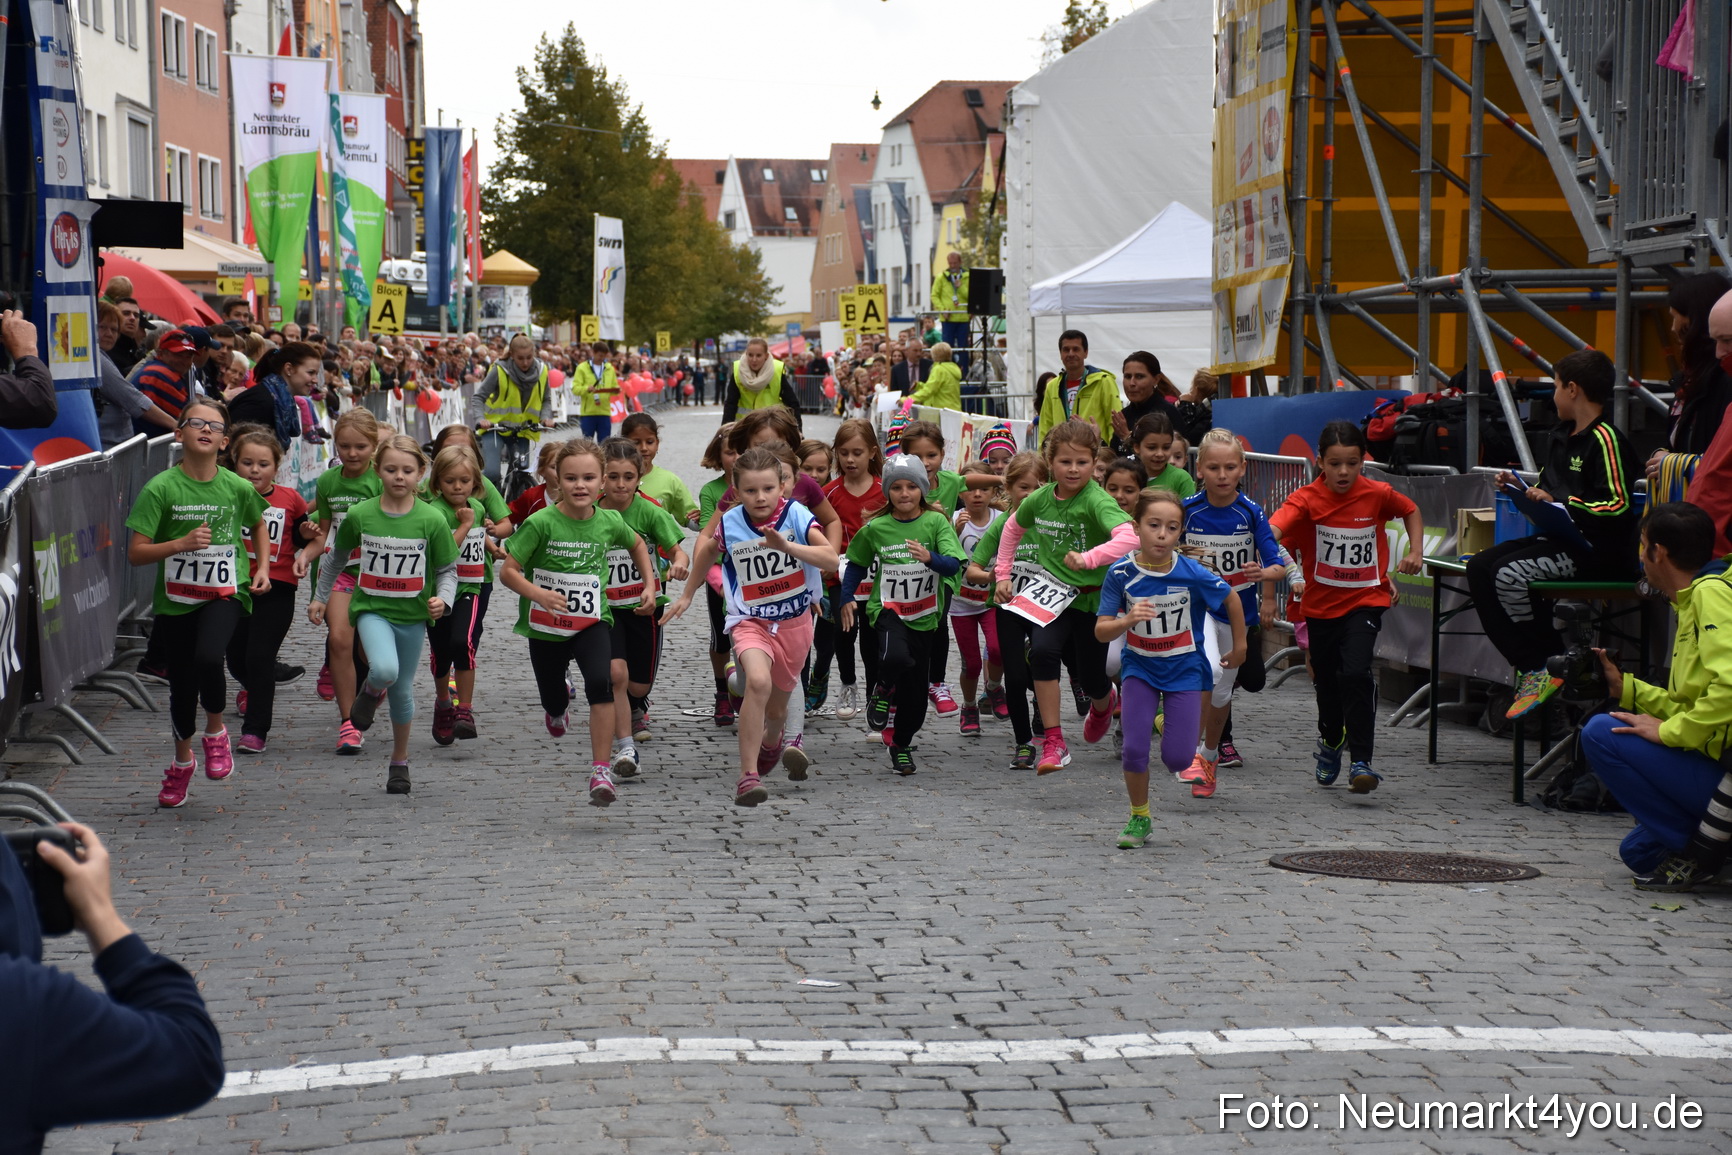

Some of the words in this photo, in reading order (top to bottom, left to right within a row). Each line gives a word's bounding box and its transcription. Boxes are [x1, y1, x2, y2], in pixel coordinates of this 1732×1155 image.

[253, 112, 301, 124] Neumarkter
[221, 264, 263, 274] Klostergasse
[377, 285, 402, 296] Block
[858, 286, 884, 296] Block
[377, 299, 396, 324] A
[845, 304, 856, 321] B
[863, 299, 881, 323] A
[585, 324, 595, 337] C
[172, 504, 218, 512] Neumarkter
[172, 513, 209, 522] Stadtlauf
[1318, 530, 1339, 540] PARTL
[1340, 533, 1370, 541] Neumarkt
[363, 540, 383, 549] PARTL
[547, 540, 592, 548] Neumarkter
[545, 548, 583, 559] Stadtlauf
[733, 547, 753, 556] PARTL
[1323, 540, 1373, 565] 7138
[367, 550, 421, 575] 7177
[739, 551, 798, 582] 7024
[172, 558, 229, 584] 7176
[608, 563, 643, 585] 708
[901, 568, 931, 576] Neumarkt
[1334, 570, 1360, 580] Sarah
[376, 579, 406, 590] Cecilia
[535, 574, 556, 585] PARTL
[557, 579, 590, 588] Neumarkt
[886, 574, 934, 600] 7174
[181, 586, 220, 599] Johanna
[758, 580, 790, 596] Sophia
[1021, 577, 1067, 609] 7437
[540, 584, 594, 614] 53
[900, 602, 923, 614] Emilia
[553, 616, 573, 628] Lisa
[1132, 607, 1184, 635] 117
[1139, 639, 1175, 650] Simone
